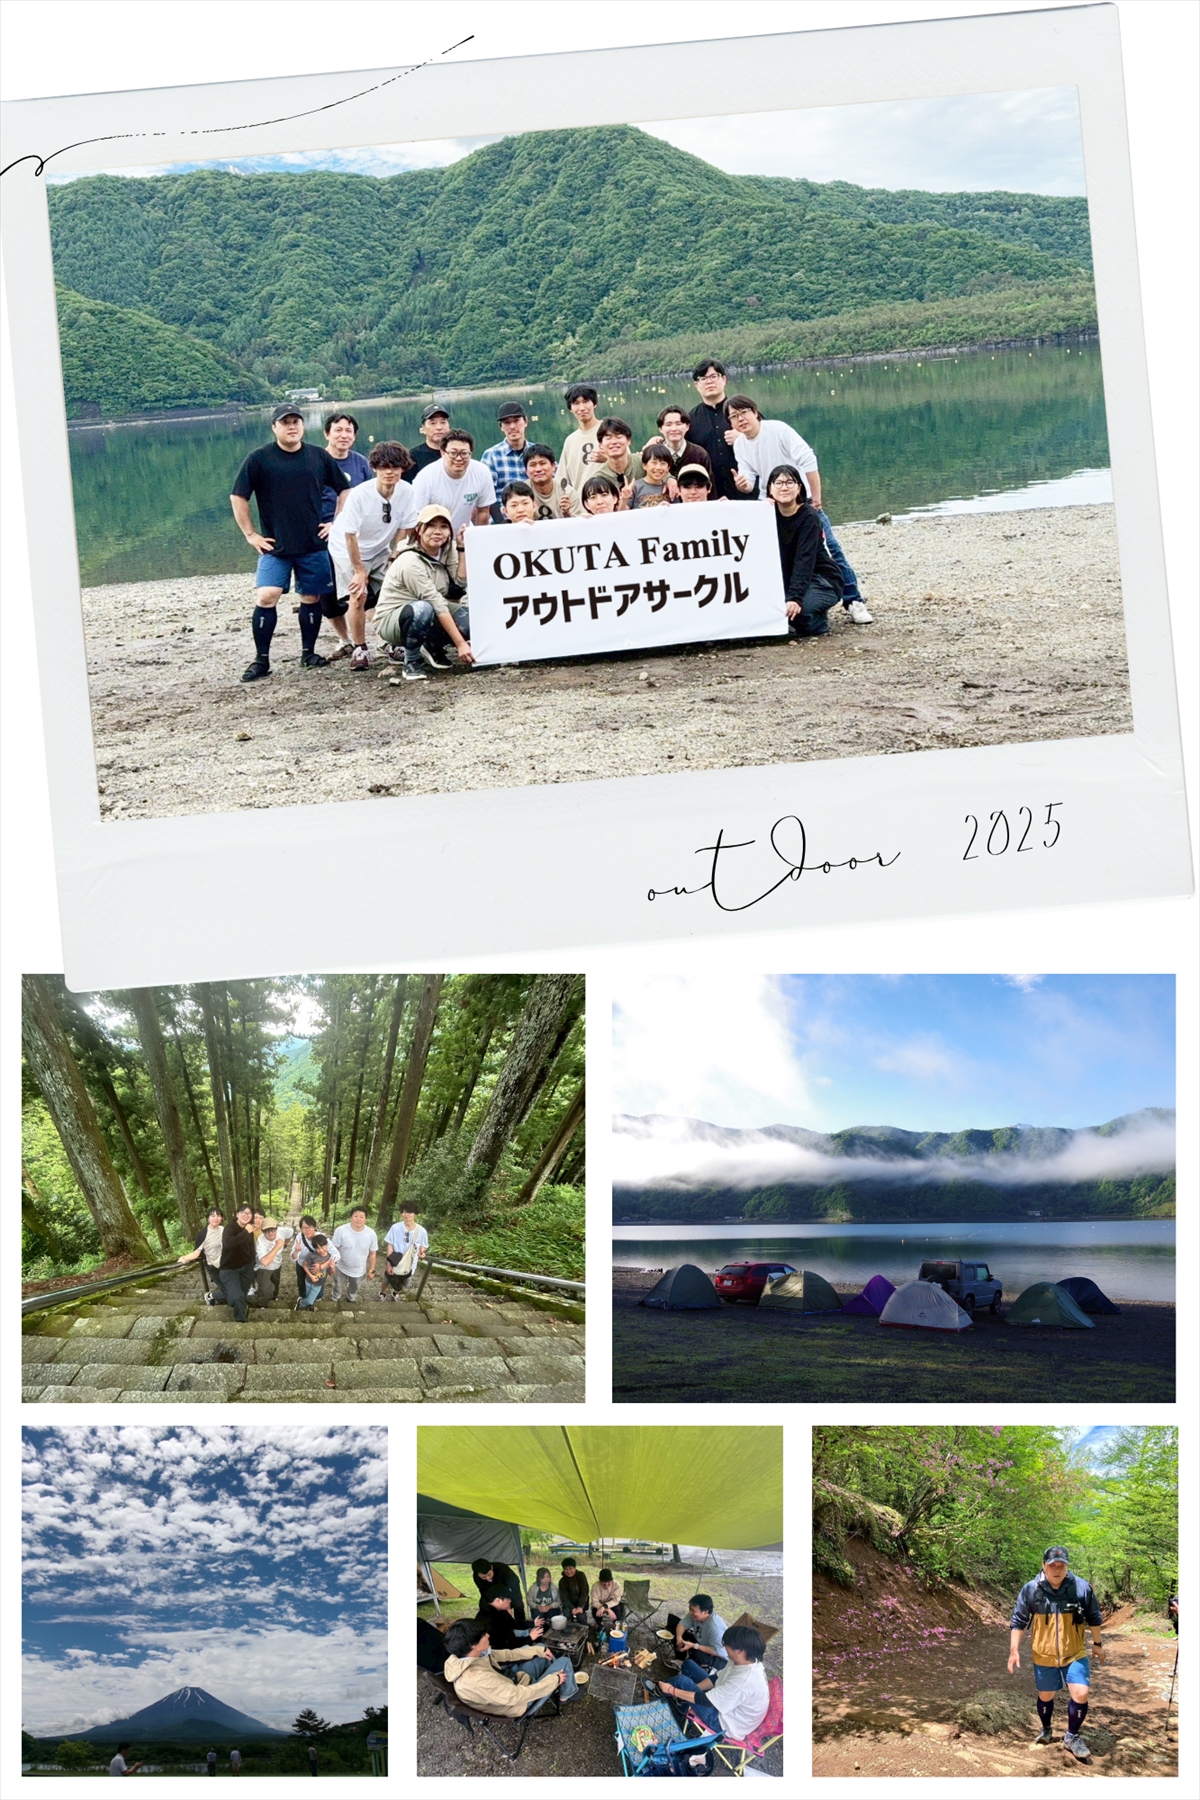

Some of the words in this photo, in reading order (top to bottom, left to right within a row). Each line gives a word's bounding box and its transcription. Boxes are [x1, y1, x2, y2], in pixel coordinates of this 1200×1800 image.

[493, 541, 630, 581] OKUTA
[638, 528, 750, 563] Family
[502, 571, 749, 630] アウトドアサークル
